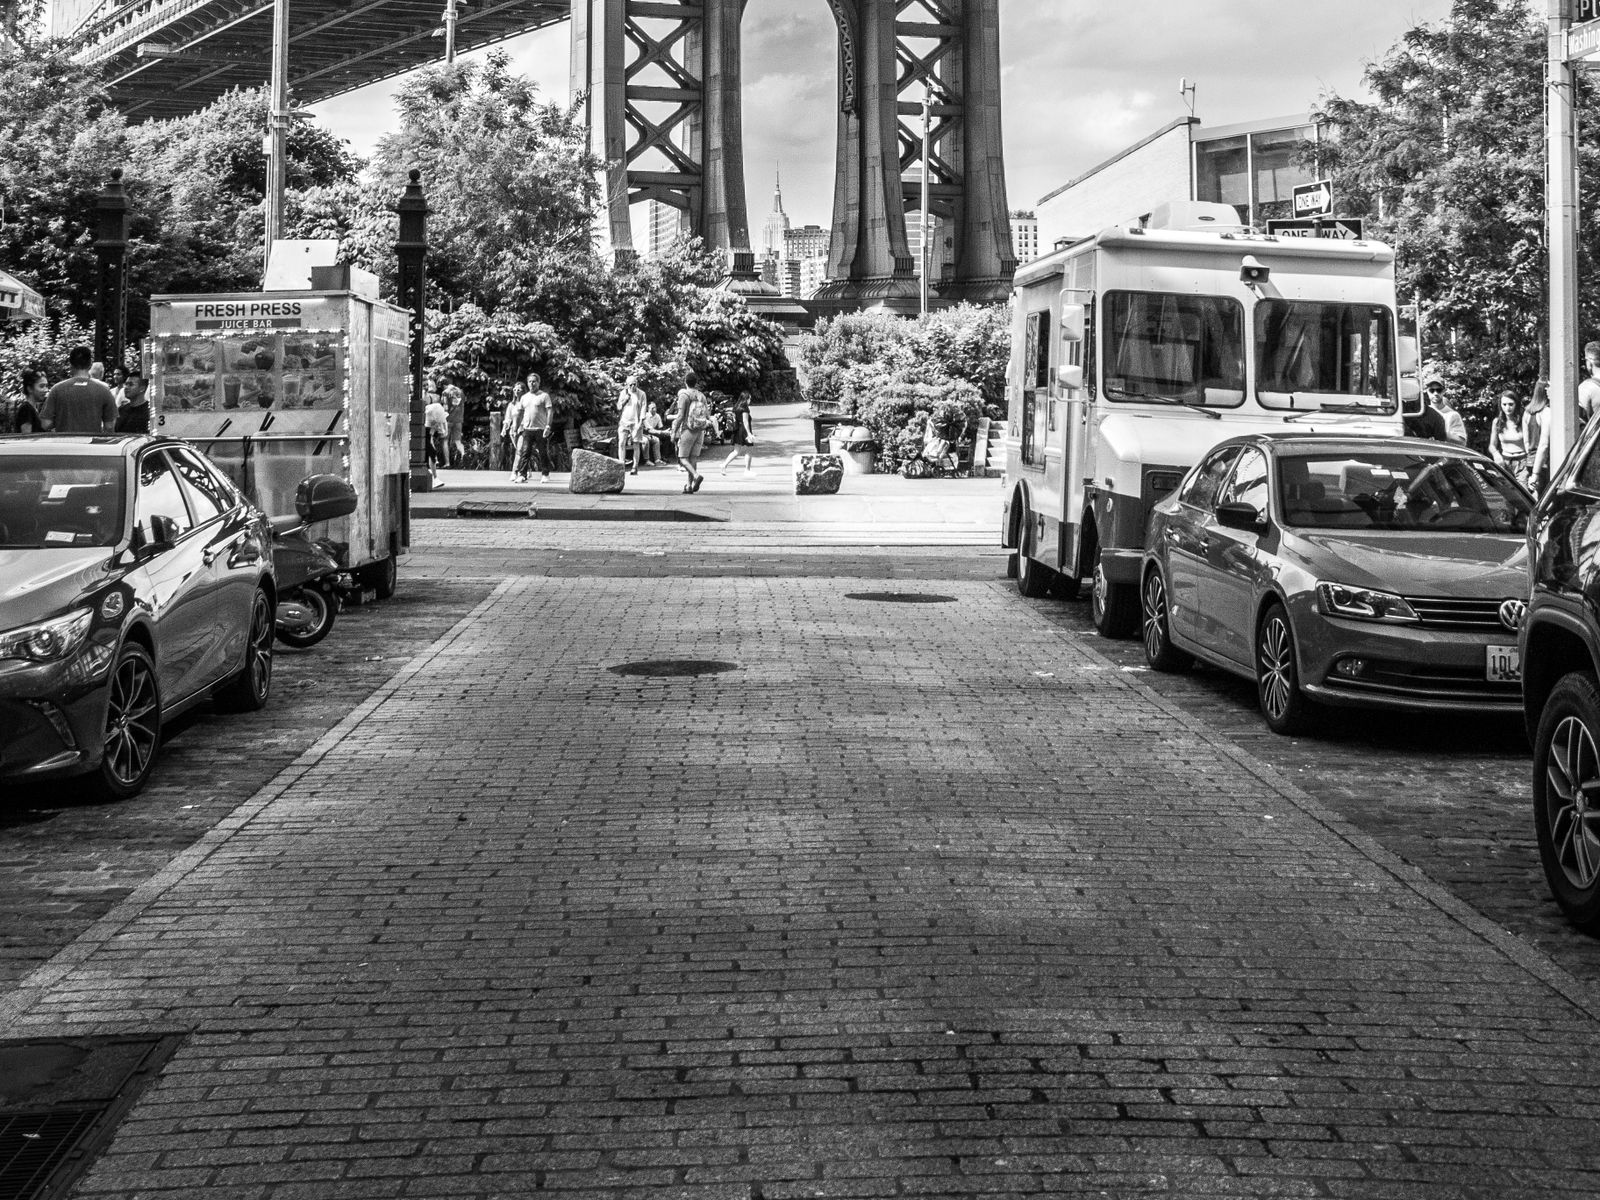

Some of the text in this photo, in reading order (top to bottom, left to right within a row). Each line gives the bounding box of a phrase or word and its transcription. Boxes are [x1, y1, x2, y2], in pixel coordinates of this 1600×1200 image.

[1298, 192, 1321, 209] ONE WAY
[195, 302, 301, 317] FRESH PRESS
[220, 319, 272, 329] JUICE BAR
[158, 415, 165, 426] 3
